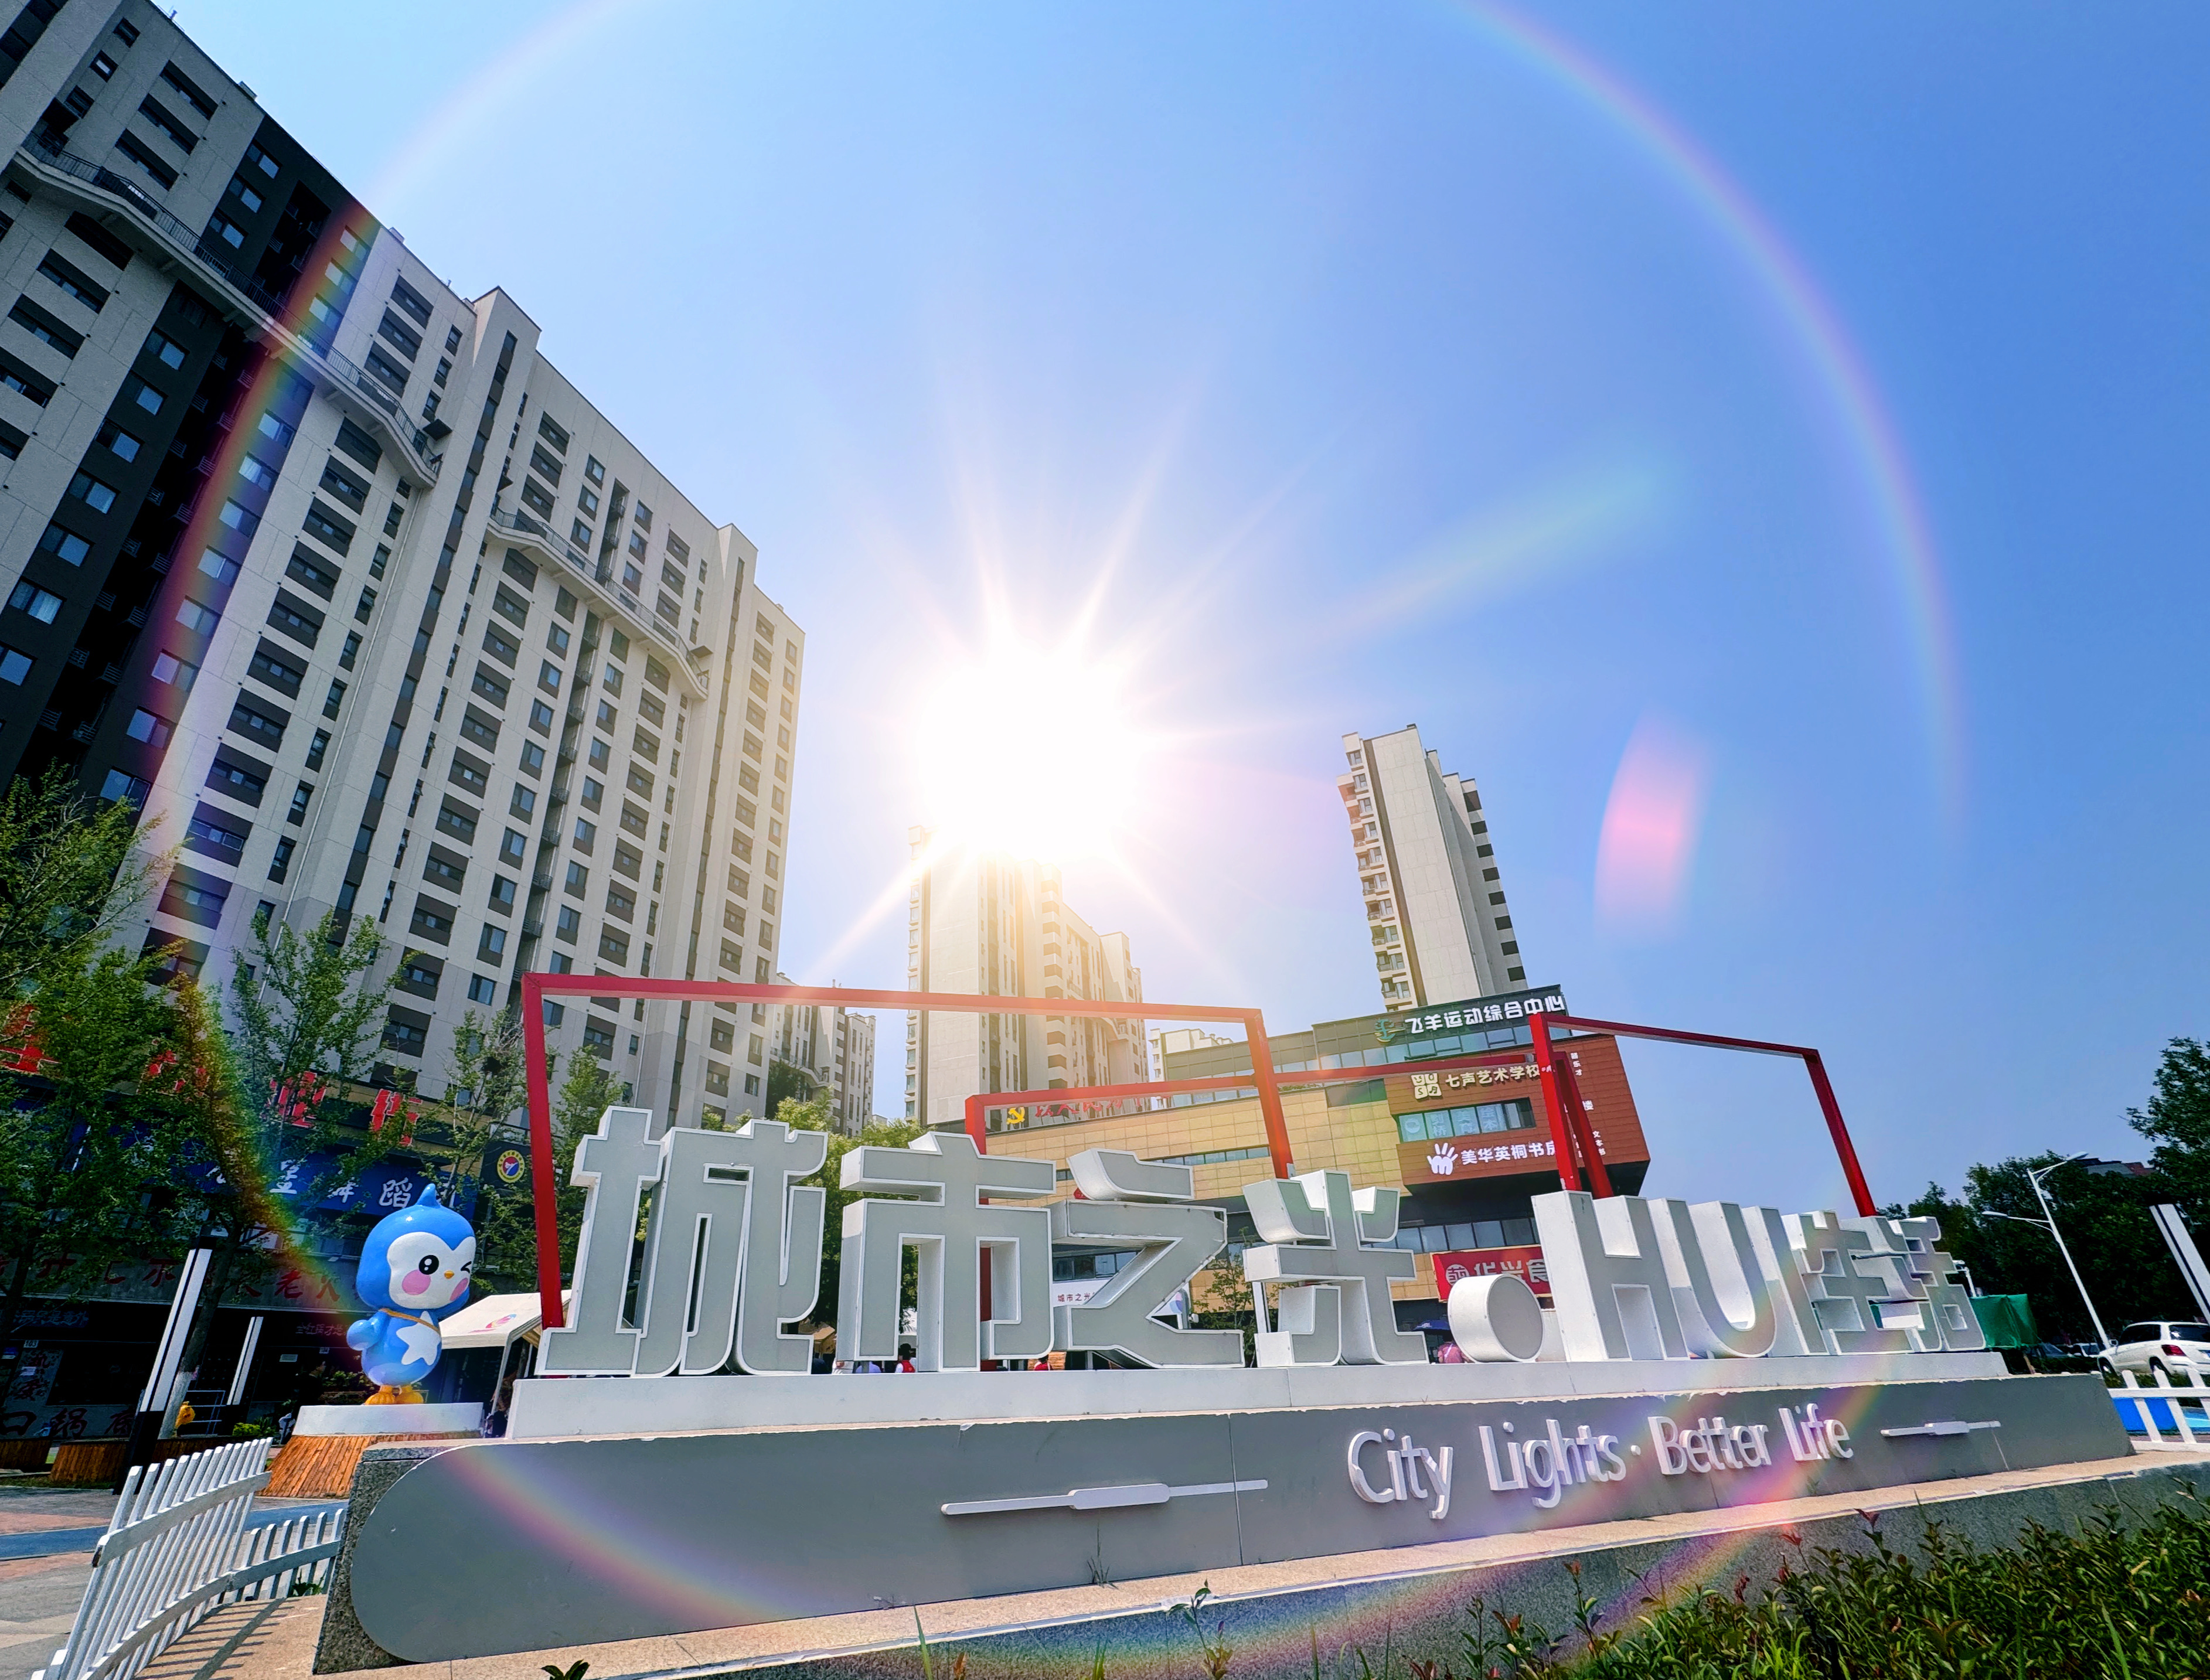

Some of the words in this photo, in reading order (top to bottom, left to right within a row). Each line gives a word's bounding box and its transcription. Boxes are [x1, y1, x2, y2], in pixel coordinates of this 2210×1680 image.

[1404, 995, 1565, 1034] 飞羊运动综合中心
[1445, 1064, 1540, 1088] 七声艺术学校
[1057, 1292, 1095, 1302] 城市之光
[1348, 1429, 1453, 1519] City
[1647, 1416, 1772, 1475] Better
[1777, 1403, 1854, 1461] Life
